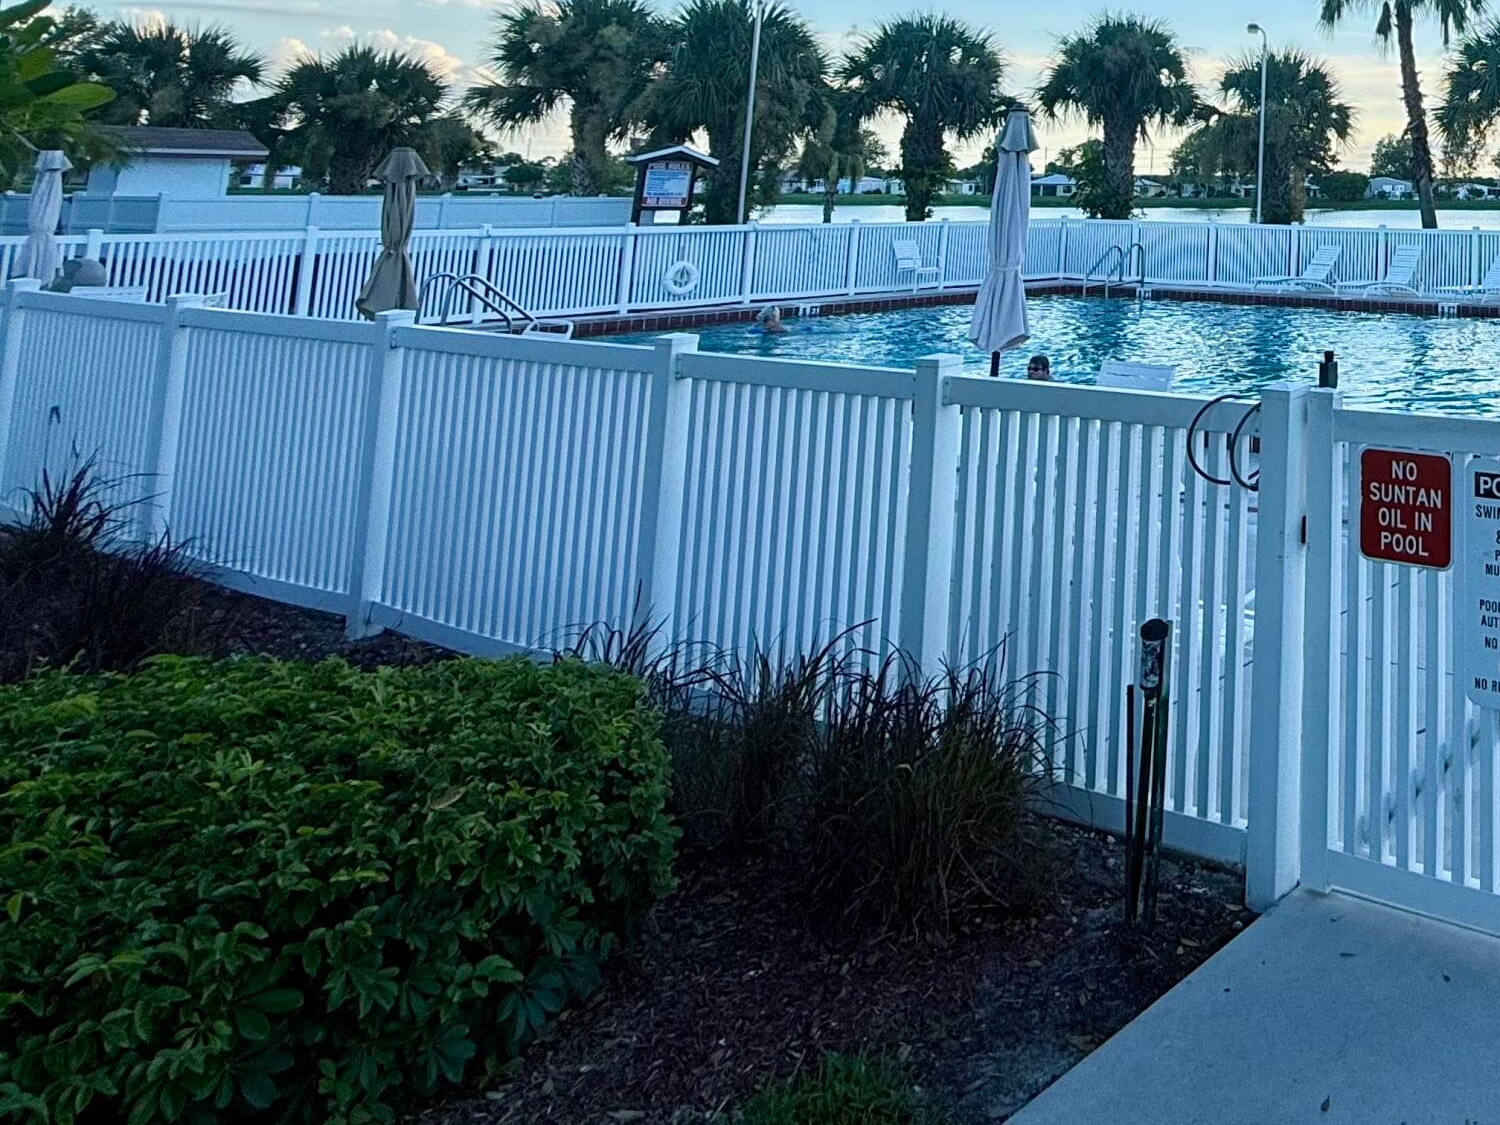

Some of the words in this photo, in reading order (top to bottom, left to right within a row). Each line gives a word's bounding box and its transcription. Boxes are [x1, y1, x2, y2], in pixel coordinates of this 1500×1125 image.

[1392, 460, 1417, 481] NO
[1370, 481, 1442, 509] SUNTAN
[1378, 507, 1407, 529] OIL
[1415, 511, 1432, 533] IN
[1381, 531, 1429, 556] POOL
[1485, 636, 1498, 649] NO
[1474, 677, 1488, 690] NO
